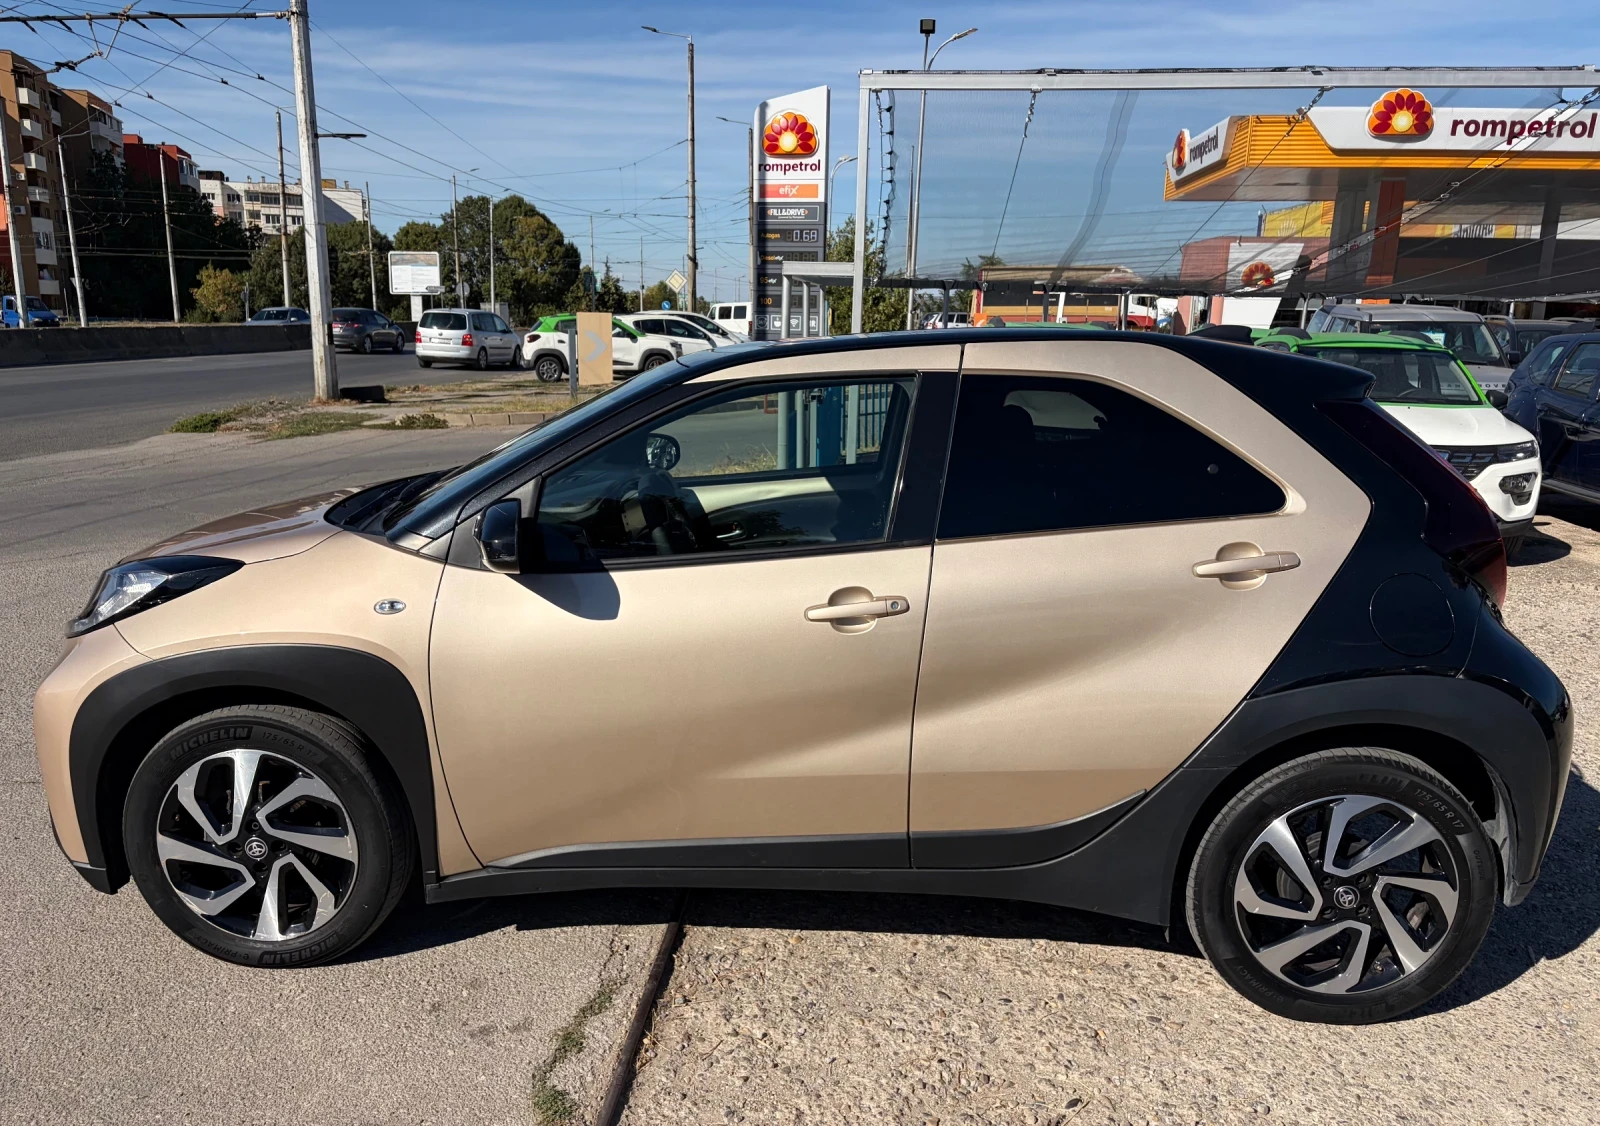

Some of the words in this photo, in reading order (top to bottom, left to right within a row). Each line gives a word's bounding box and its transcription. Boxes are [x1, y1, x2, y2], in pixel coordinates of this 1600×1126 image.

[1450, 112, 1598, 145] rompetrol
[1189, 125, 1219, 164] rompetrol
[758, 159, 821, 175] rompetrol
[779, 185, 799, 197] efix
[760, 297, 772, 305] 100
[170, 727, 248, 760] MICHELIN
[262, 731, 296, 749] 175/65
[1413, 788, 1446, 813] 175/65
[1444, 808, 1455, 819] R
[1452, 818, 1465, 829] 17
[262, 934, 339, 964] MICHELIN
